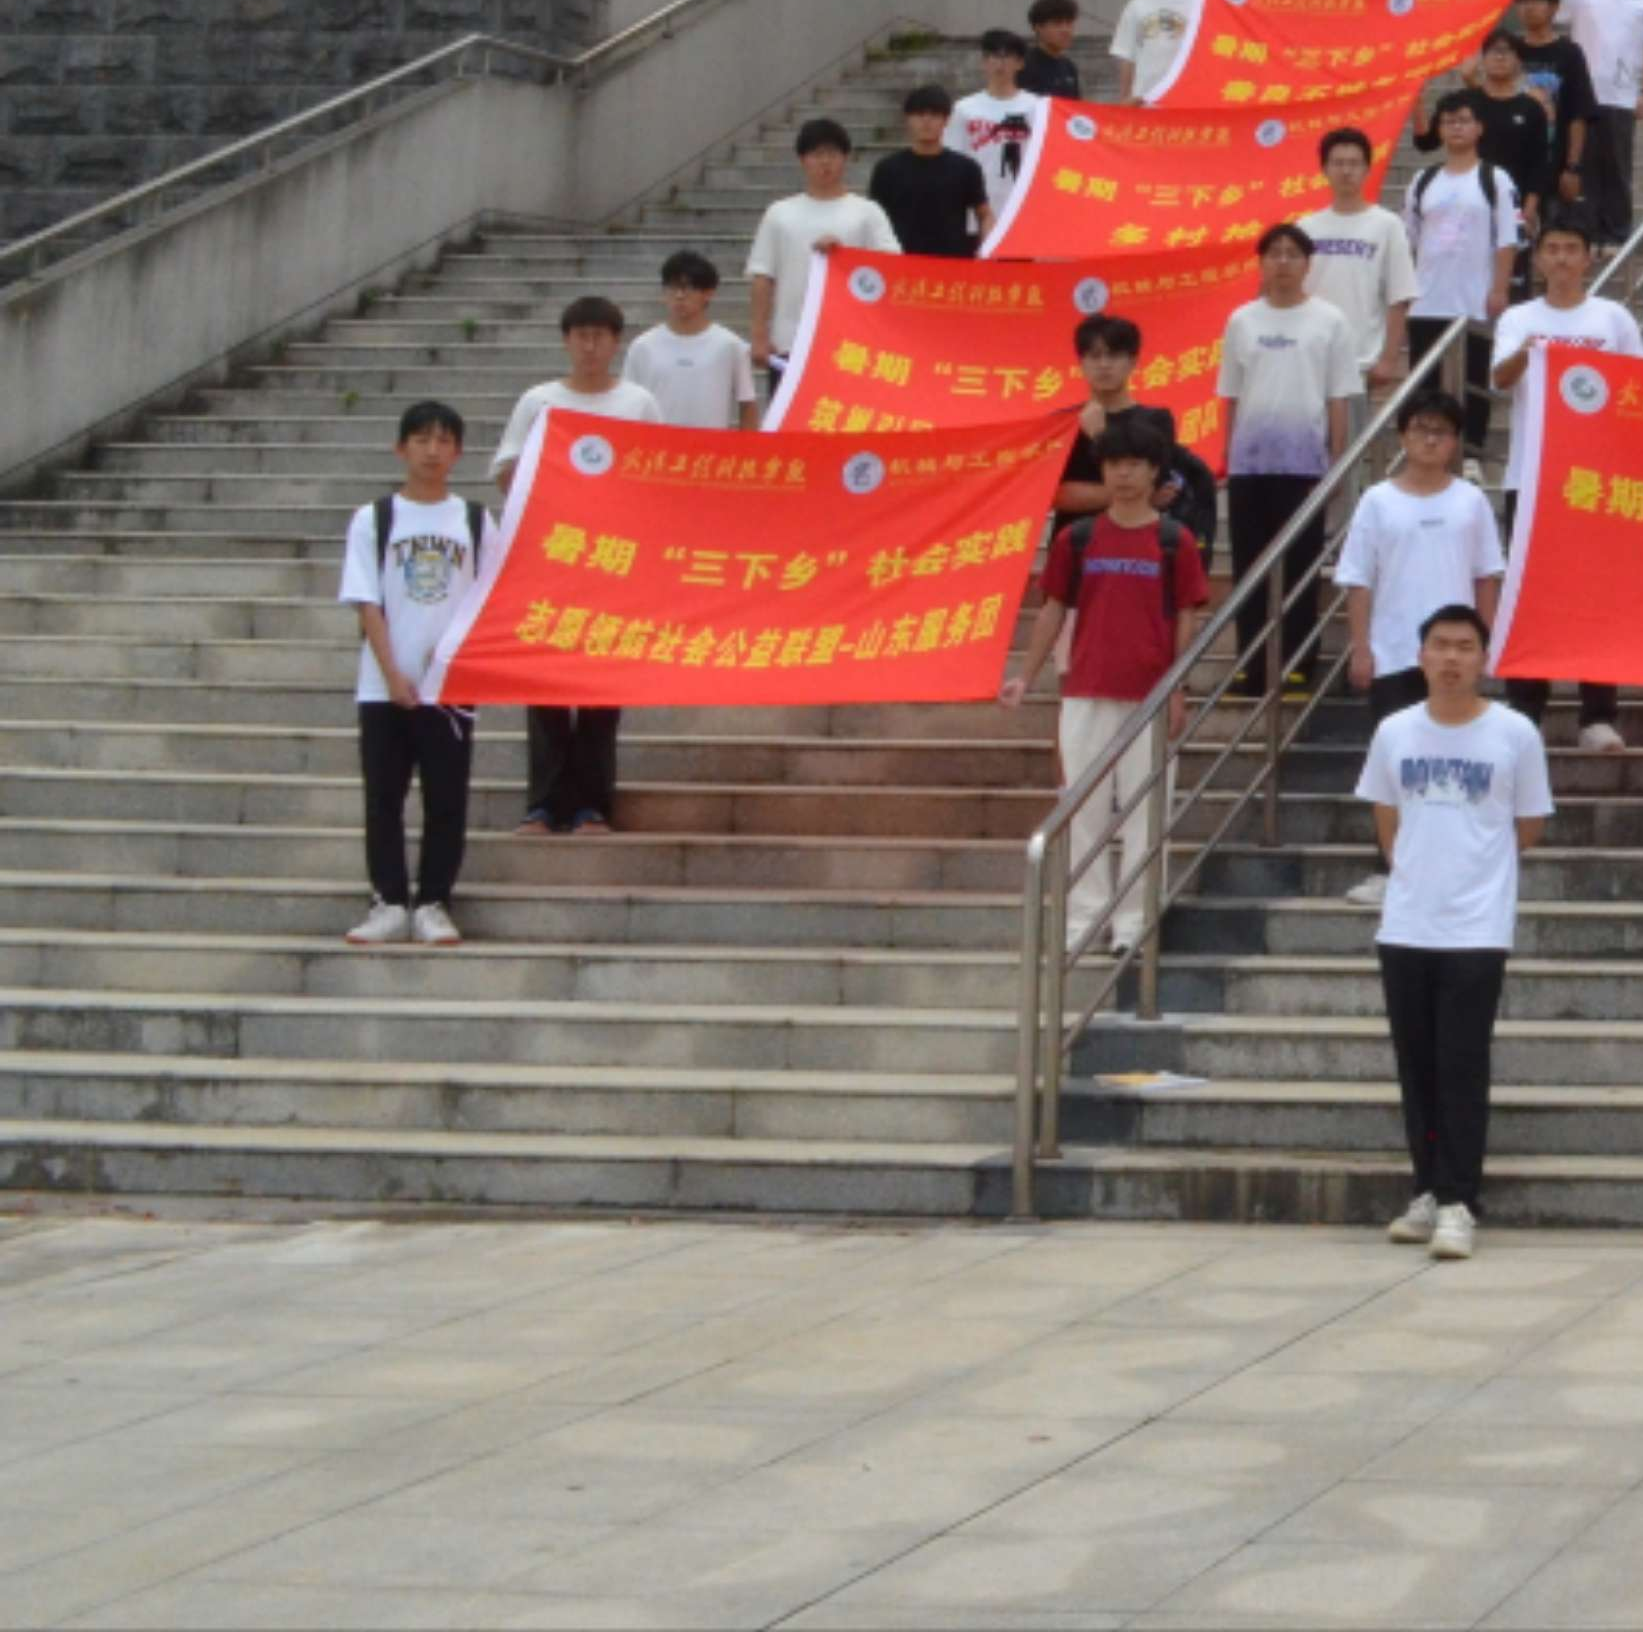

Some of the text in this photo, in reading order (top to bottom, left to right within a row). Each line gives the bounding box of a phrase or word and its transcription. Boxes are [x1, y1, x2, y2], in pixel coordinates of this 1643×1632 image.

[832, 340, 913, 386] 暑期
[540, 517, 1034, 592] 暑期 “三下乡” 社会实践
